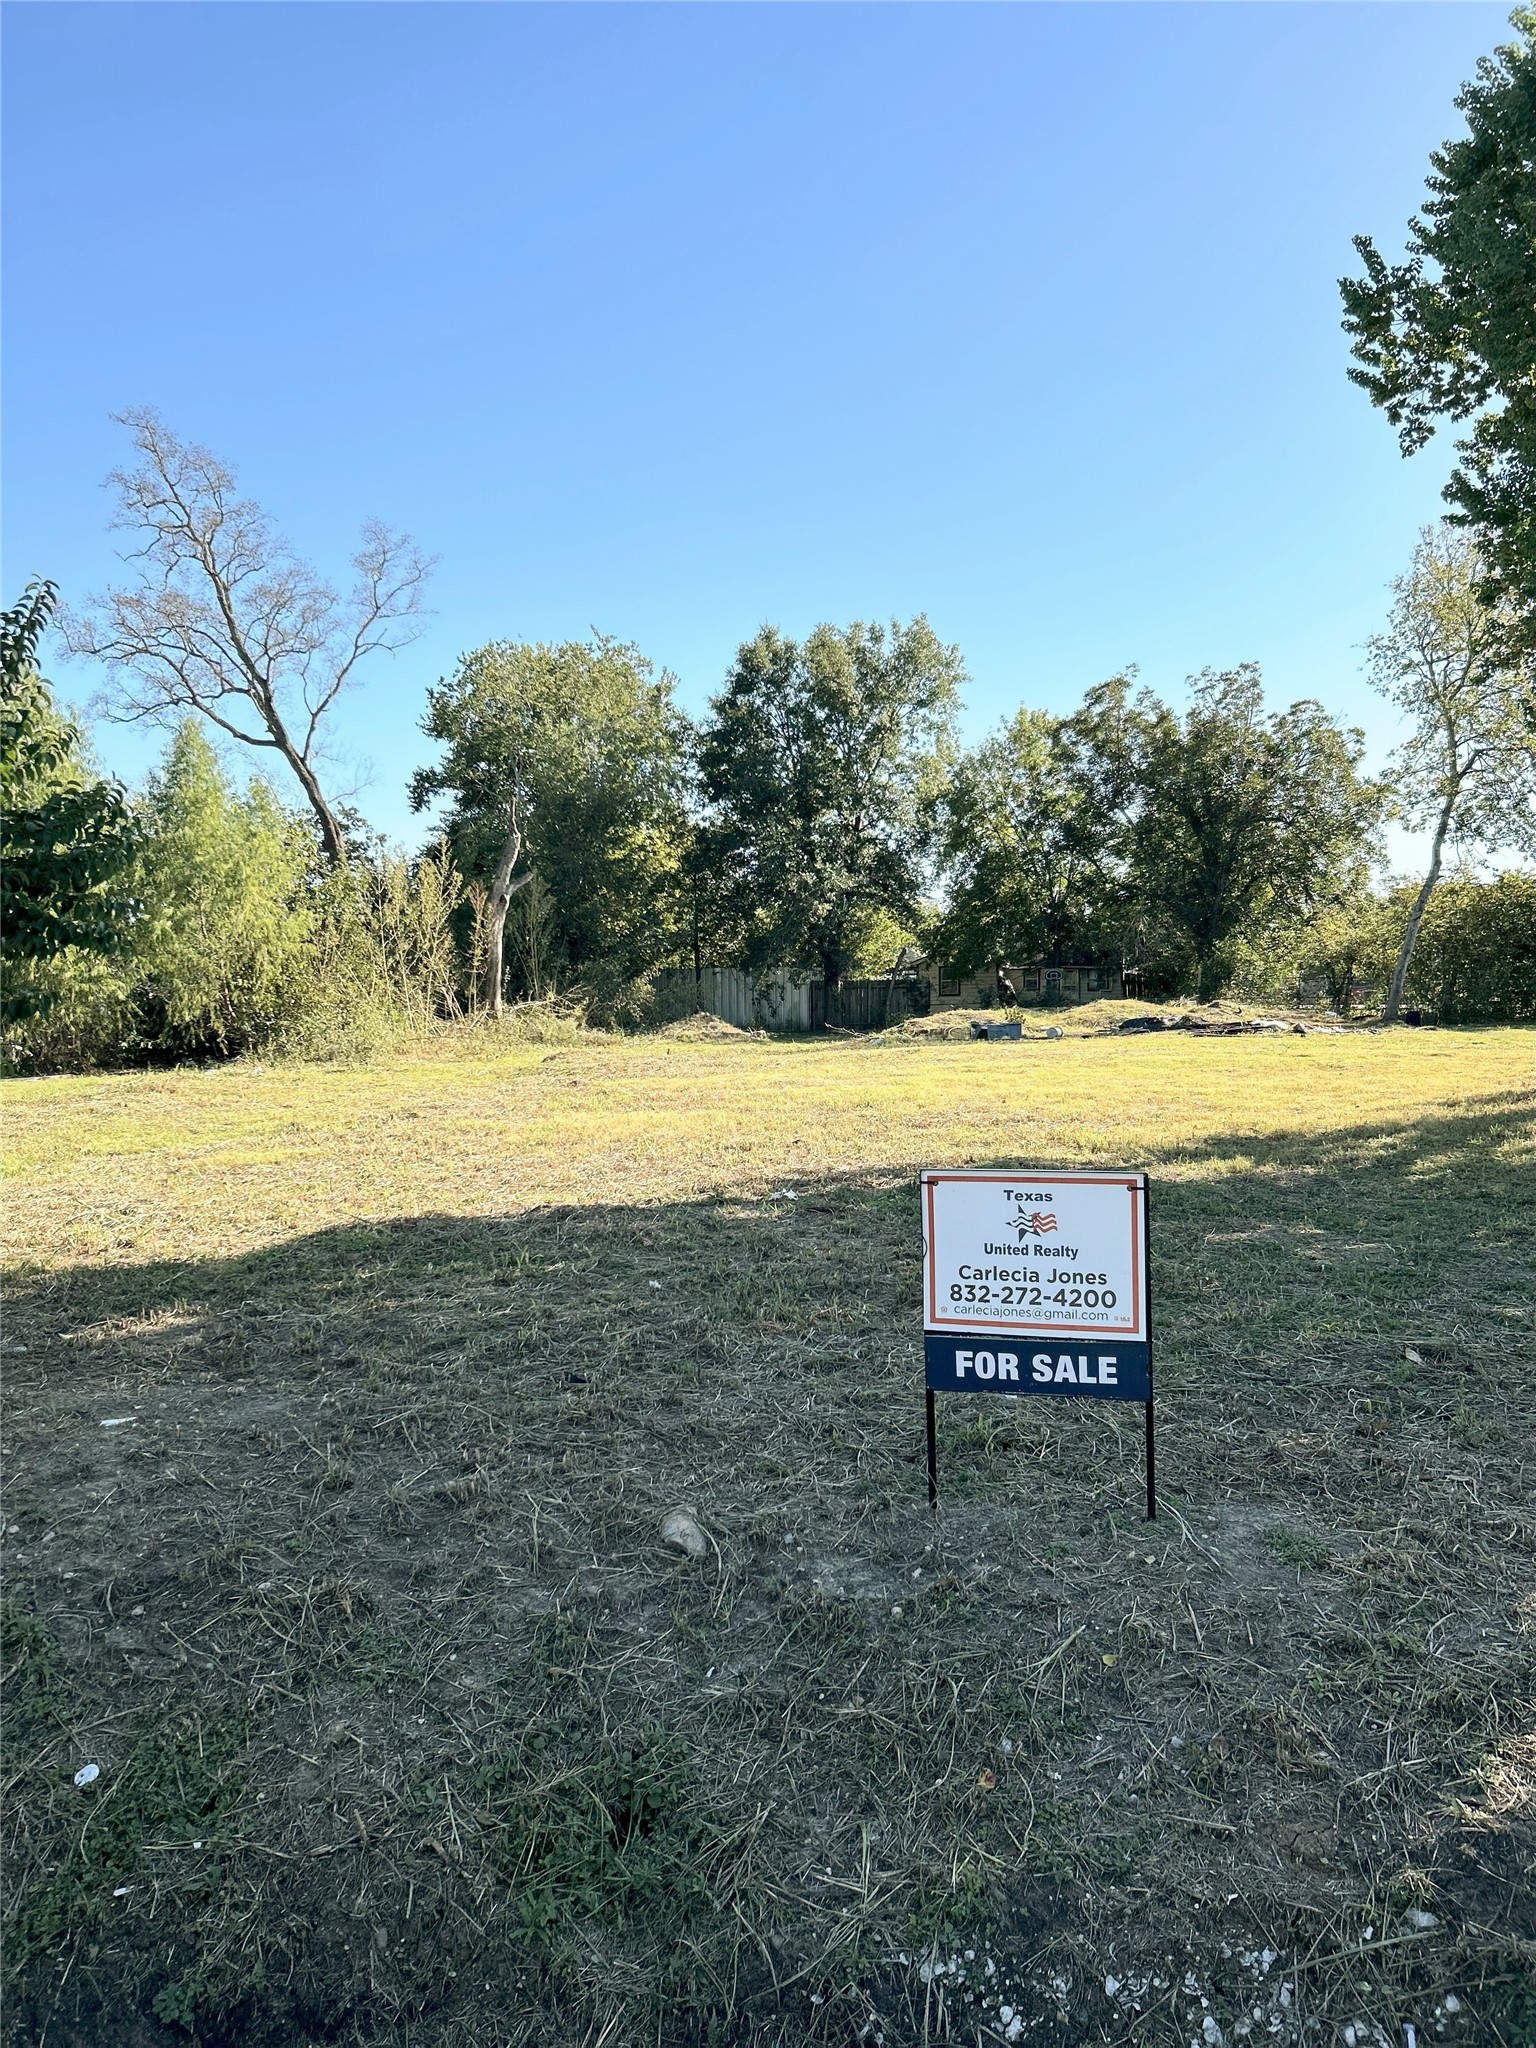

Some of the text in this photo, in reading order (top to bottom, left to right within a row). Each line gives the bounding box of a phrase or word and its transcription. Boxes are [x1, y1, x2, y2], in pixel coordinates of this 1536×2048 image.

[1003, 1189, 1053, 1202] Texas
[984, 1243, 1079, 1260] United Realty
[958, 1265, 1107, 1285] Carlecia Jones
[949, 1283, 1117, 1308] 832-272-4200
[954, 1305, 1109, 1321] carleciajones@gmail.com
[955, 1350, 1118, 1385] FOR SALE
